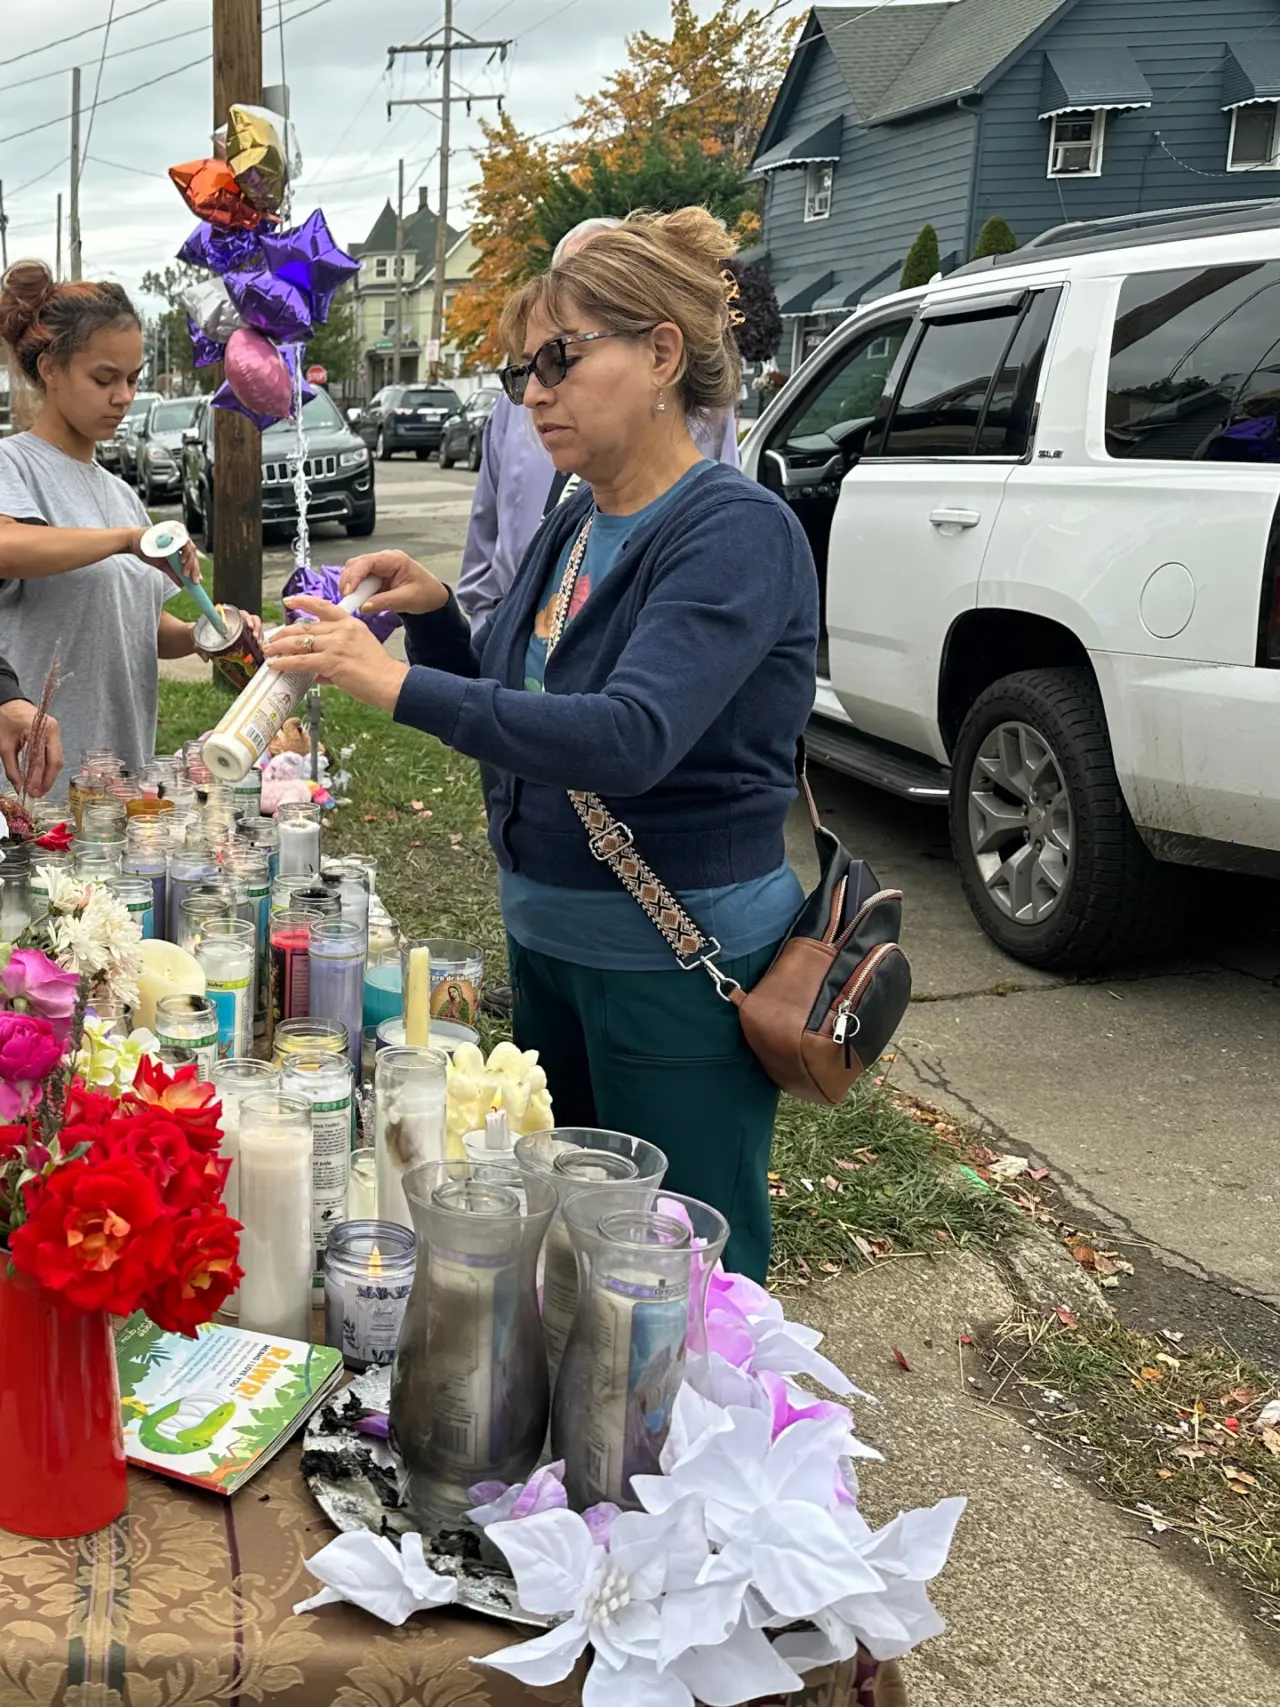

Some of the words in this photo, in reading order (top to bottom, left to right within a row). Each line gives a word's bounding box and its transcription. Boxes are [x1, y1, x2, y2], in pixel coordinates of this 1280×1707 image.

[252, 1344, 271, 1361] MEANS
[230, 1346, 292, 1401] RAWR!
[239, 1363, 253, 1376] LOVE
[229, 1377, 243, 1387] YOU
